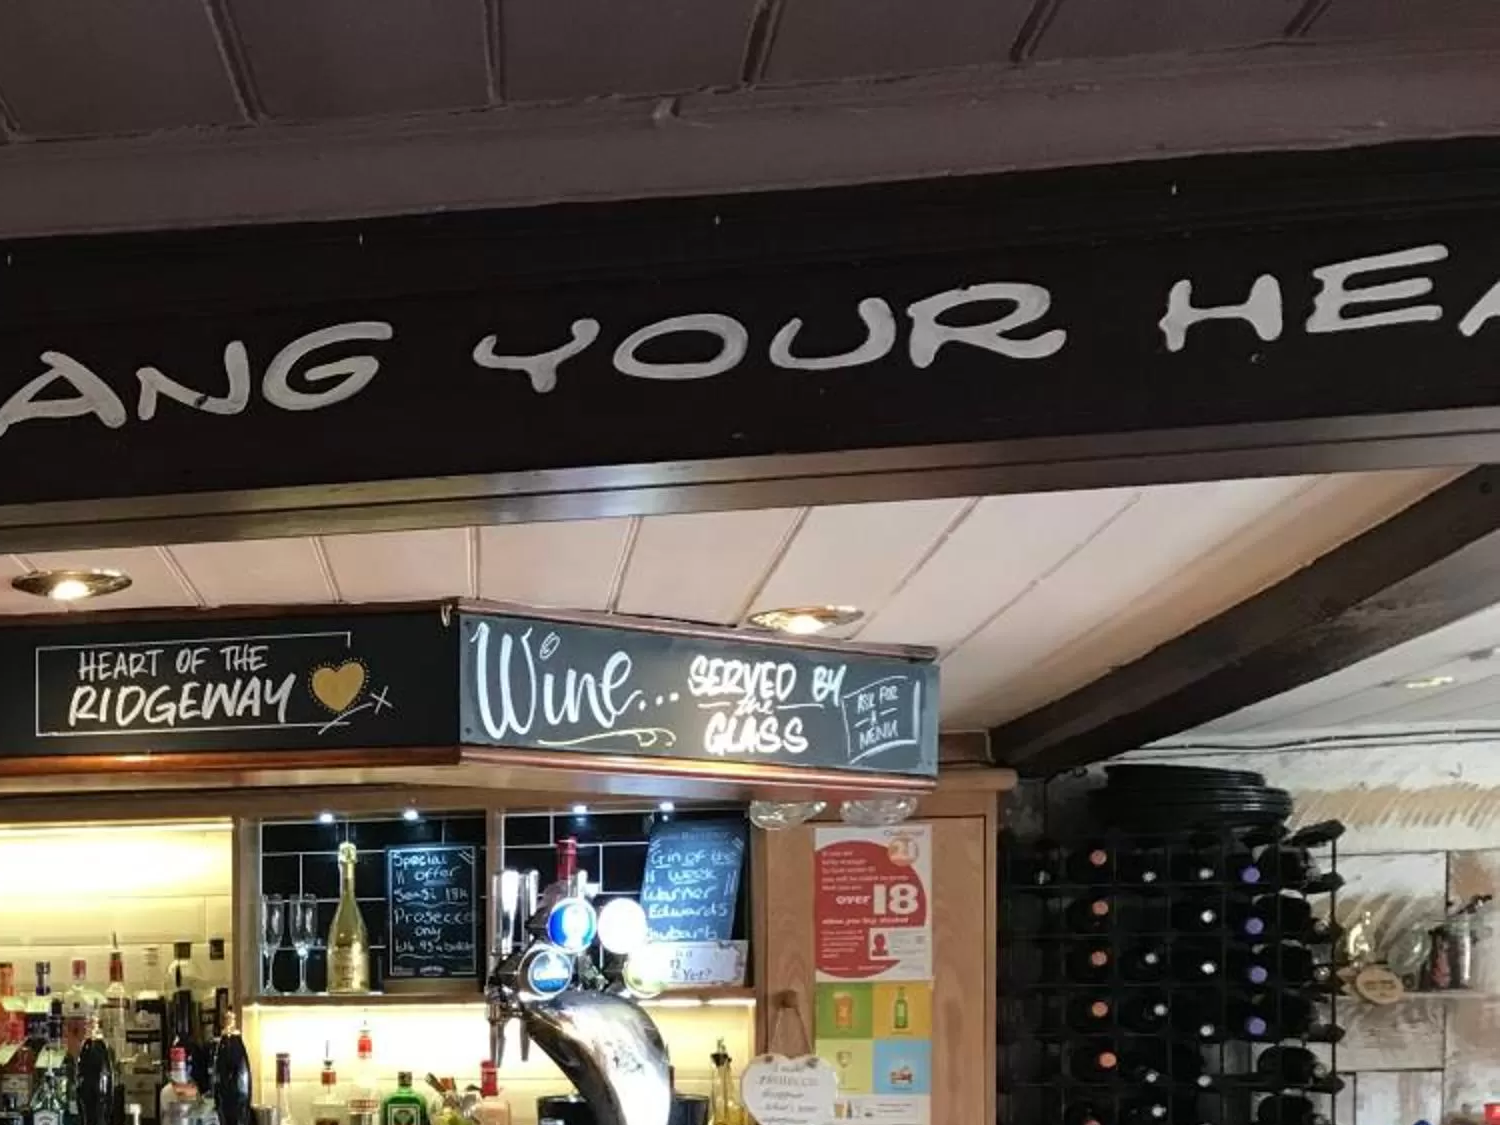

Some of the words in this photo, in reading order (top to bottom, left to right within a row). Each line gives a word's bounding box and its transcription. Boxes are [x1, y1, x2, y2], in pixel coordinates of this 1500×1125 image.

[473, 283, 1066, 392] YOUR
[79, 649, 164, 681] HEART
[176, 648, 210, 674] OF
[220, 645, 269, 671] THE
[688, 655, 797, 701] SERVED
[812, 664, 847, 706] BY
[68, 673, 297, 727] RIDGEWAY
[734, 695, 774, 716] the
[704, 711, 809, 756] GLASS
[393, 853, 448, 870] Special
[414, 866, 461, 881] offer
[836, 895, 871, 905] over
[873, 884, 918, 914] 18
